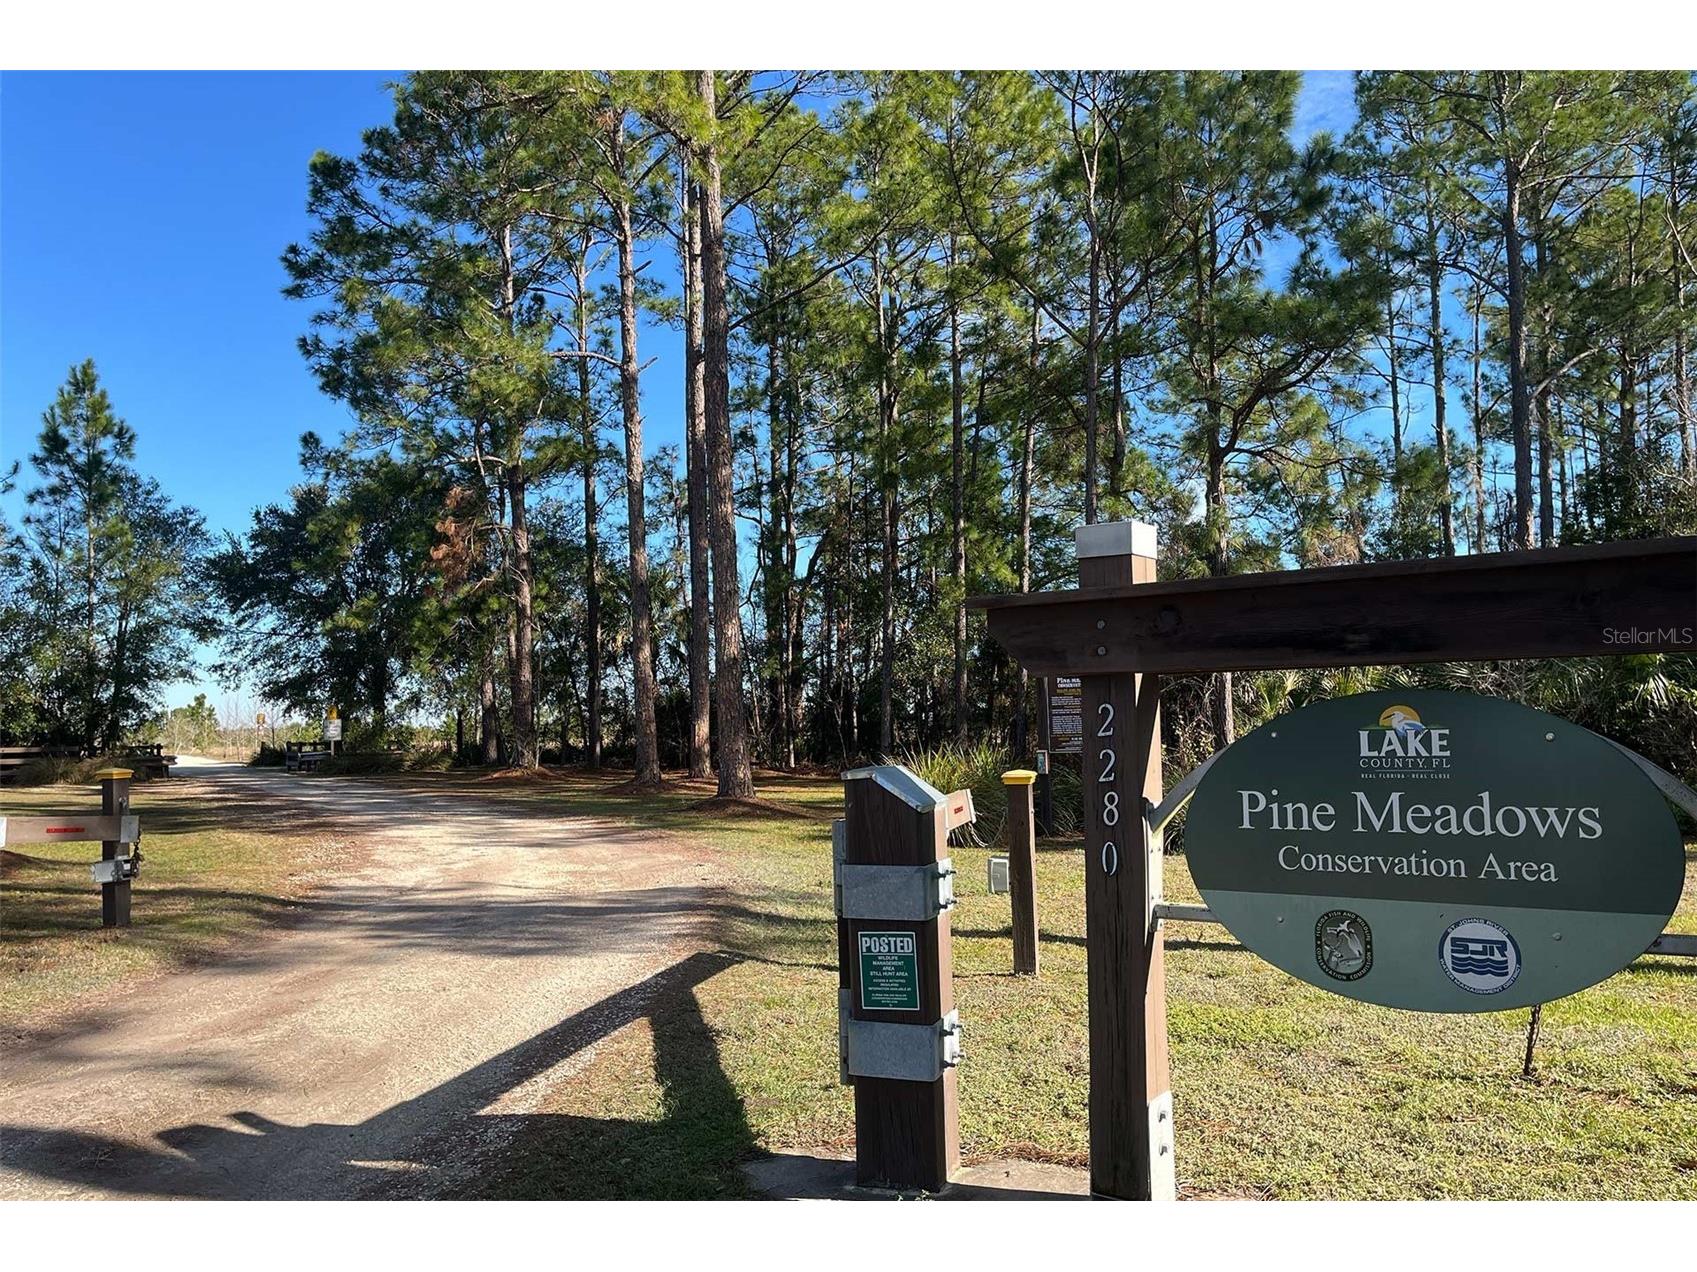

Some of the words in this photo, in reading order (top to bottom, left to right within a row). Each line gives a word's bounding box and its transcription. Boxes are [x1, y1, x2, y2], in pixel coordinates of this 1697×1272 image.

[1358, 729, 1451, 757] LAKE
[1360, 758, 1427, 769] COUNTY,
[1432, 758, 1451, 769] FL
[1097, 703, 1119, 876] 2280
[1237, 789, 1336, 832] Pine
[1351, 791, 1603, 839] Meadows
[1278, 845, 1468, 878] Conservation
[1477, 852, 1559, 882] Area
[861, 936, 914, 953] POSTED
